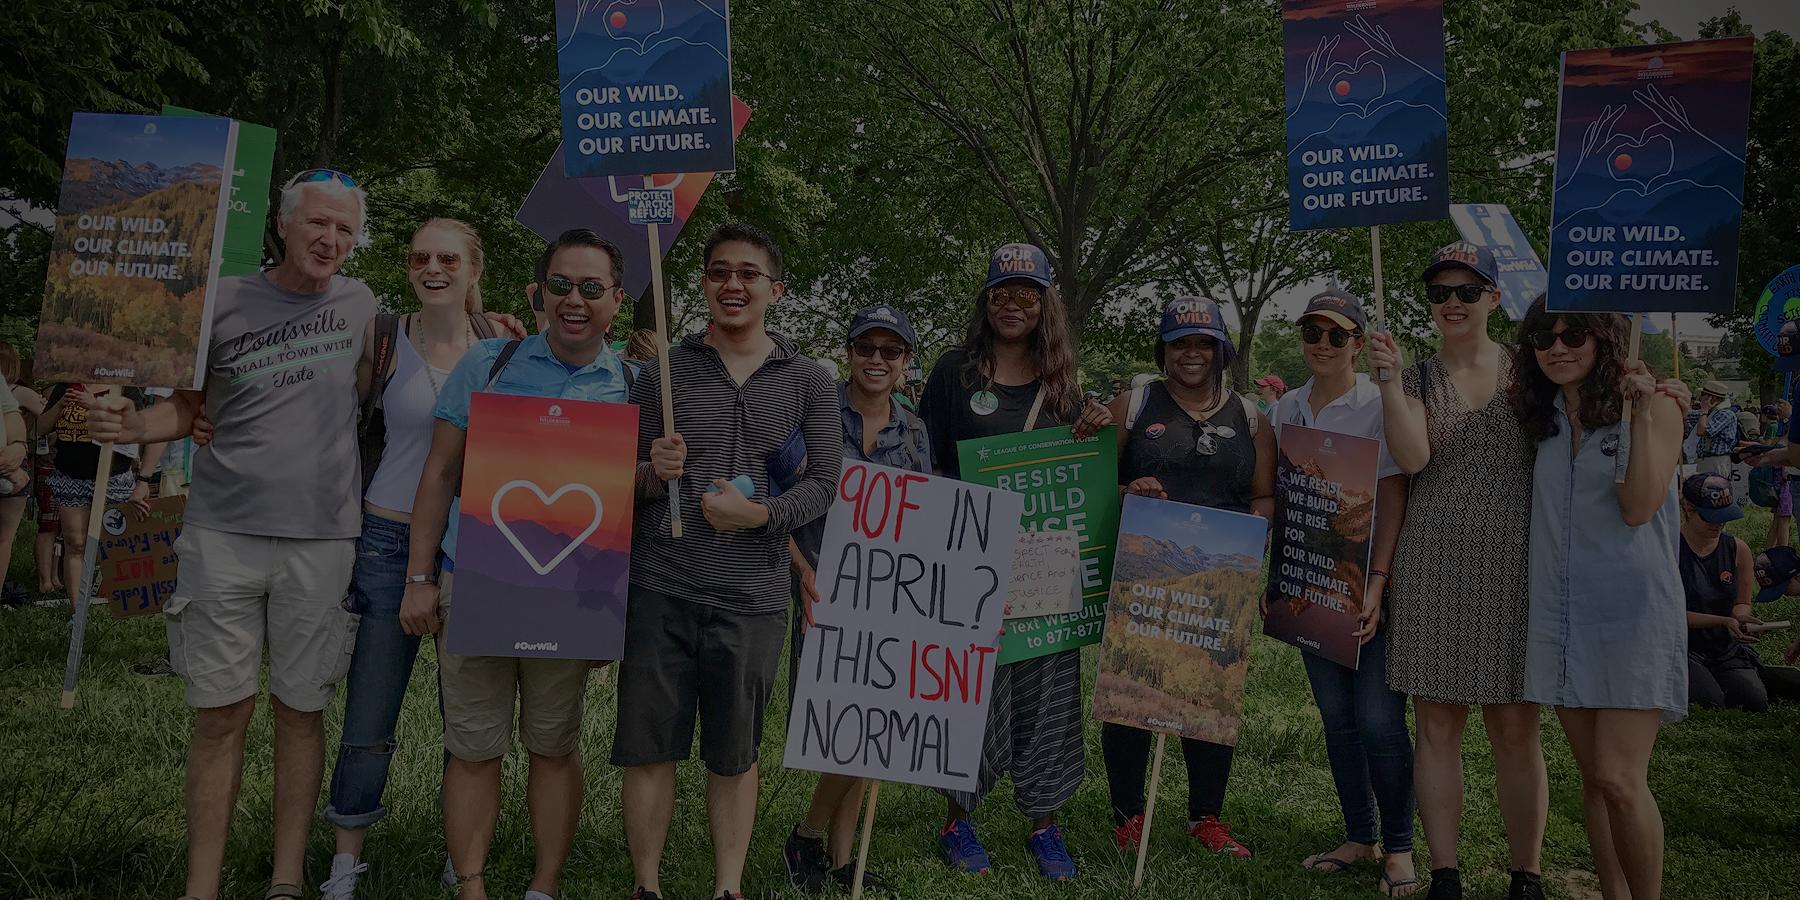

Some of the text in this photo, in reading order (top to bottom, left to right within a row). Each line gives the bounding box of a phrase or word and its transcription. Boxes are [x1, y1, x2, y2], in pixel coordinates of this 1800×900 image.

[576, 84, 684, 105] OUR WILD.
[577, 107, 716, 131] OUR CLIMATE.
[578, 132, 711, 155] OUR FUTURE.
[1301, 143, 1403, 166] OUR WILD.
[1302, 163, 1434, 188] OUR CLIMATE.
[629, 191, 671, 201] PROTECT
[638, 200, 672, 209] ARCTIC
[1303, 186, 1428, 210] OUR FUTURE.
[77, 215, 169, 234] OUR WILD.
[630, 208, 672, 219] REFUGE
[1568, 225, 1686, 243] OUR WILD.
[73, 237, 193, 258] OUR CLIMATE.
[1001, 248, 1033, 262] OUR
[1440, 251, 1479, 265] WILD
[1443, 242, 1478, 256] OUR
[1566, 249, 1720, 266] OUR CLIMATE.
[69, 259, 182, 281] OUR FUTURE.
[999, 260, 1035, 273] WILD
[1564, 273, 1710, 291] OUR FUTURE.
[1175, 312, 1212, 325] WILD
[1177, 302, 1209, 314] OUR
[228, 308, 348, 362] Louisville
[277, 345, 319, 363] TOWN
[323, 338, 353, 353] WITH
[93, 367, 136, 378] #OurWild
[272, 366, 315, 388] Taste
[993, 447, 1017, 456] LEAGUE
[1018, 444, 1027, 452] OF
[1029, 438, 1074, 450] CONSERVATION
[997, 463, 1082, 491] RESIST
[1289, 472, 1307, 487] WE
[1022, 487, 1086, 517] UILD
[1288, 490, 1340, 515] WE BUILD.
[946, 488, 991, 552] IN
[1286, 508, 1330, 531] WE RISE.
[1284, 526, 1306, 543] FOR
[1283, 545, 1337, 572] OUR WILD.
[830, 542, 998, 629] APRIL?
[1281, 563, 1353, 596] OUR CLIMATE.
[1132, 583, 1214, 610] OUR WILD.
[1280, 580, 1346, 613] OUR FUTURE.
[1009, 618, 1041, 634] Text
[1128, 601, 1234, 634] OUR CLIMATE.
[514, 641, 558, 651] #OurWild
[1027, 635, 1042, 649] to
[1125, 621, 1226, 652] OUR FUTURE.
[815, 623, 995, 705] THIS ISN'T
[802, 698, 969, 778] NORMAL
